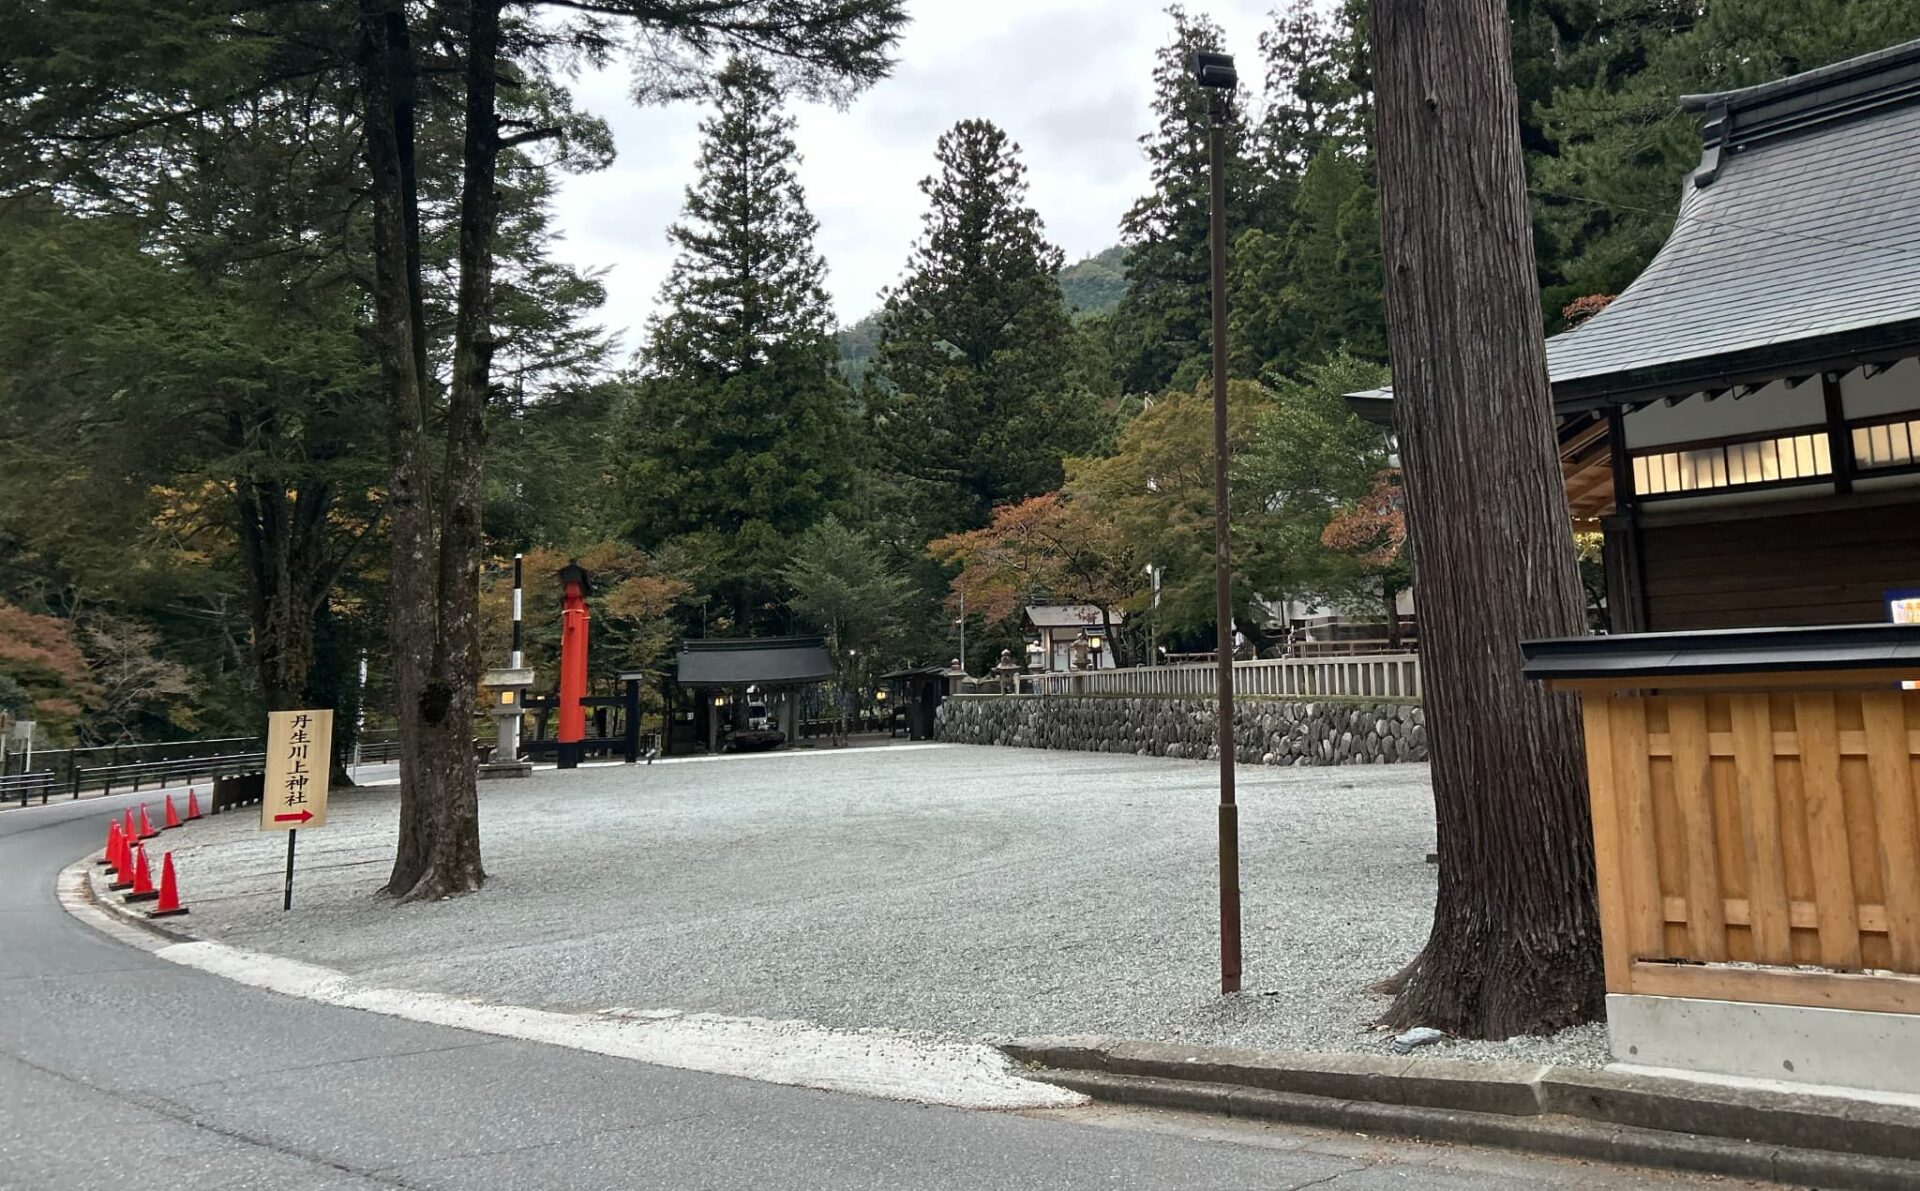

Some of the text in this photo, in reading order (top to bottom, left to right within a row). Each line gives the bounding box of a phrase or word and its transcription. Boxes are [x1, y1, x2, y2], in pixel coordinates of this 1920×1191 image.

[284, 714, 312, 807] 丹生川上神社
